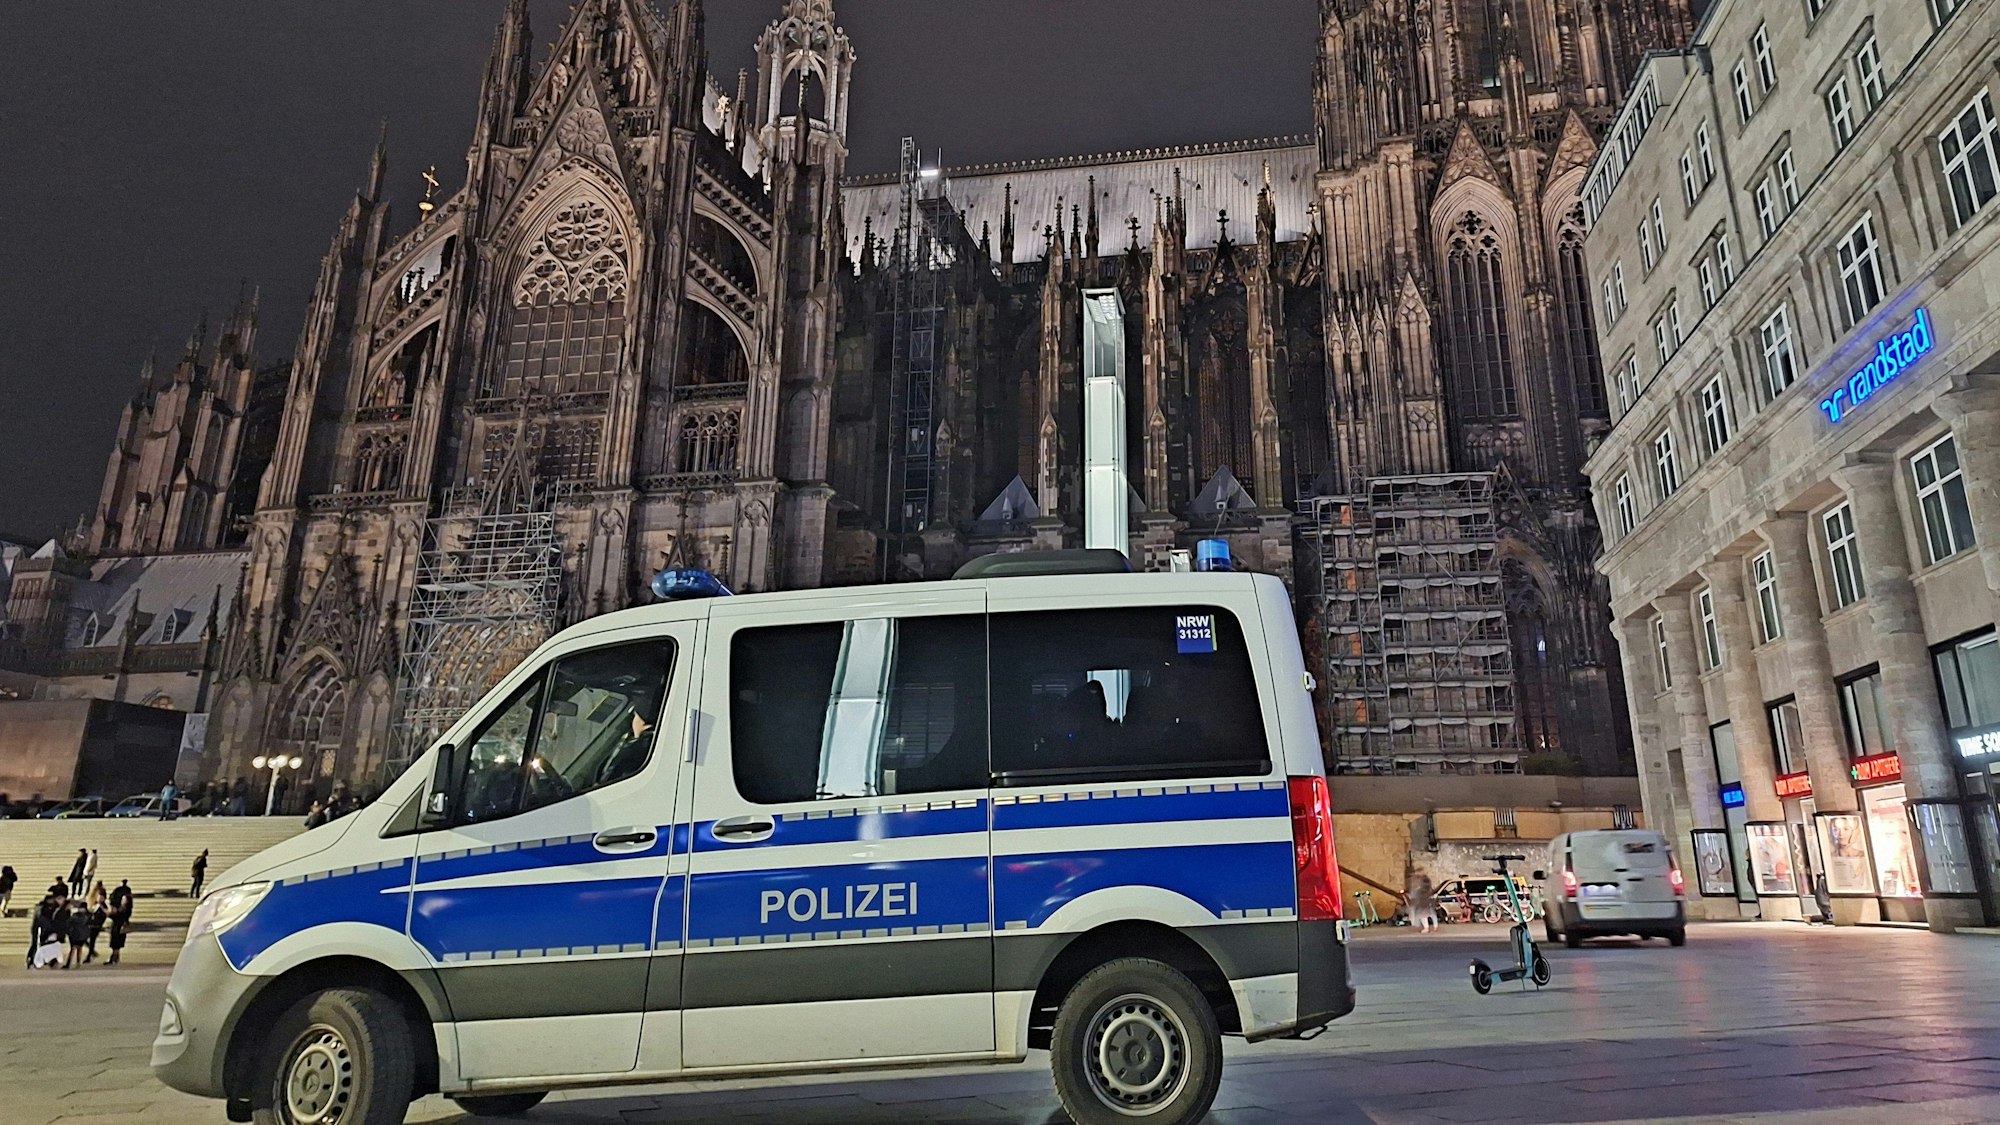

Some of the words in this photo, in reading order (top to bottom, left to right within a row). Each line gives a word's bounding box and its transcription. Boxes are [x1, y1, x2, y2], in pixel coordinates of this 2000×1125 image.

[1849, 307, 1932, 406] randstad
[1176, 615, 1210, 628] NRW
[1179, 628, 1212, 640] 31312
[760, 881, 918, 924] POLIZEI
